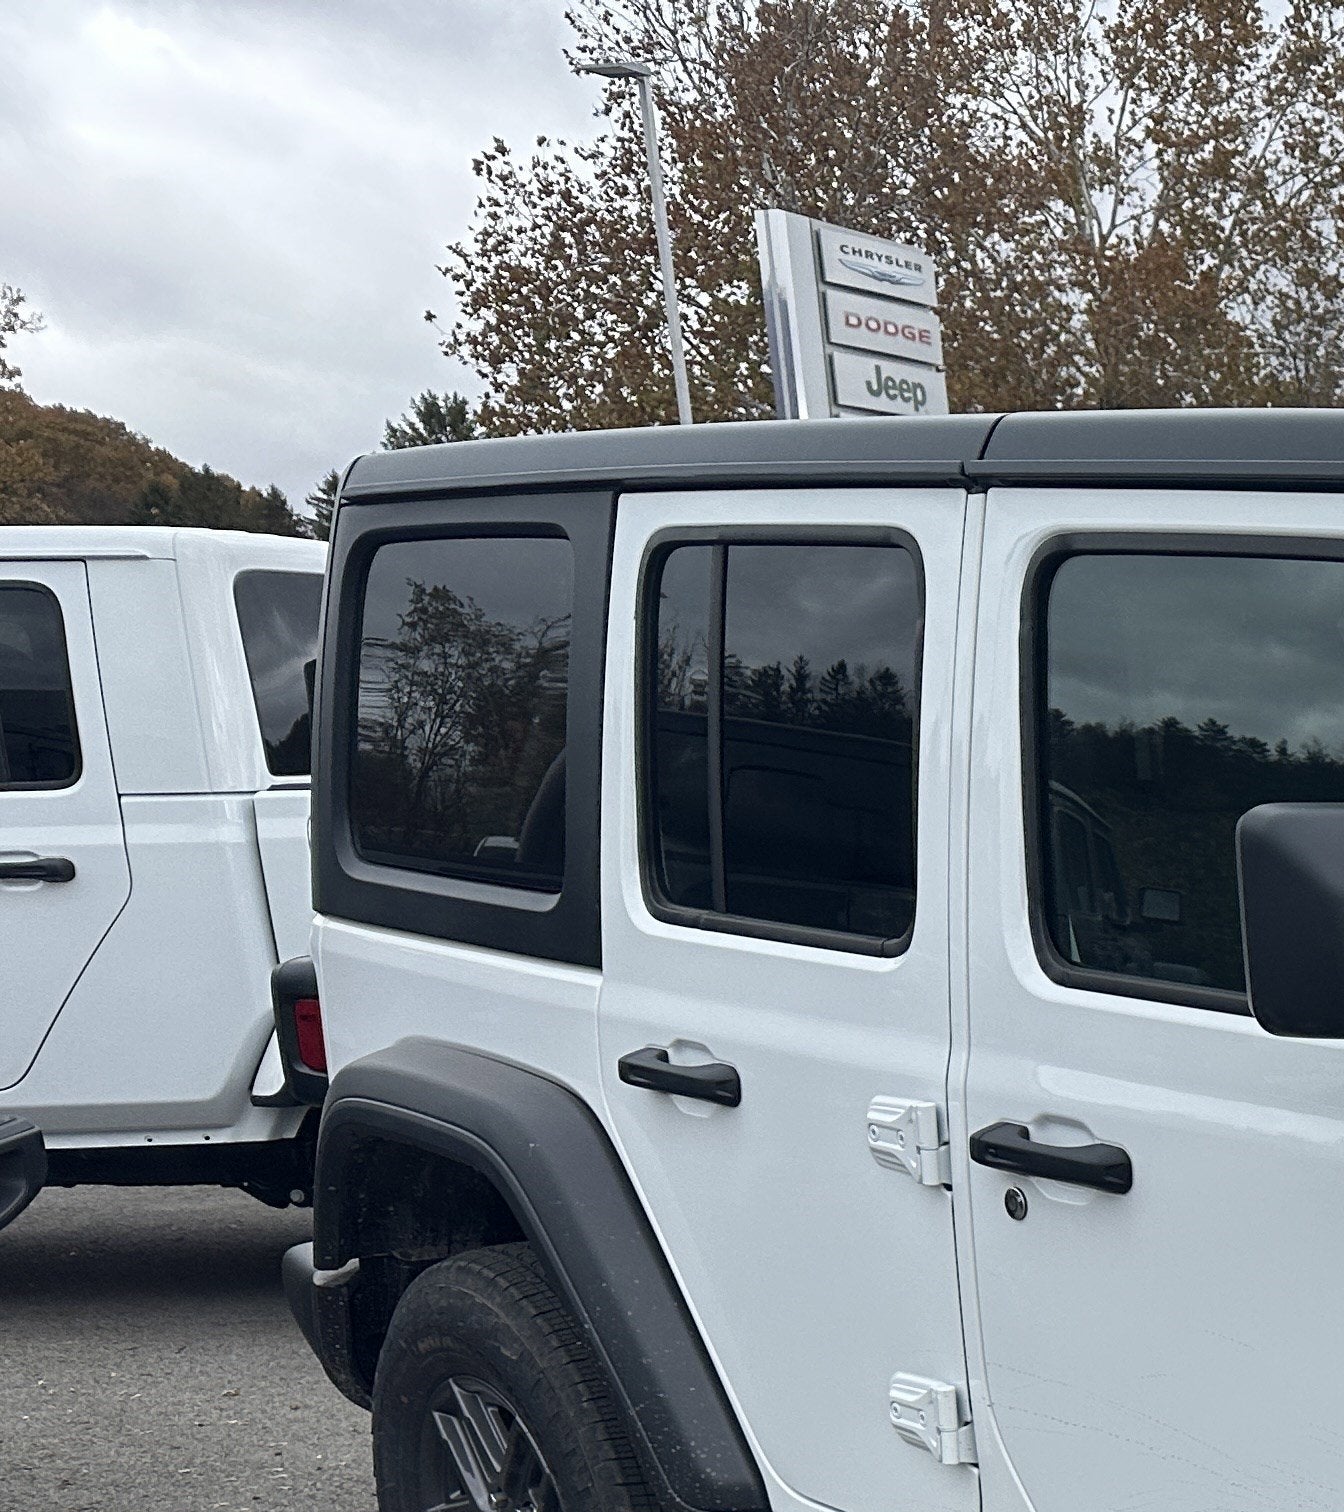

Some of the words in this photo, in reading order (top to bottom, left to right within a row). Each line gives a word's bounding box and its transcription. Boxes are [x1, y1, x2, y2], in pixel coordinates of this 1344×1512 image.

[840, 245, 922, 273] CHRYSLER
[844, 312, 932, 345] DODGE
[865, 365, 927, 411] Jeep
